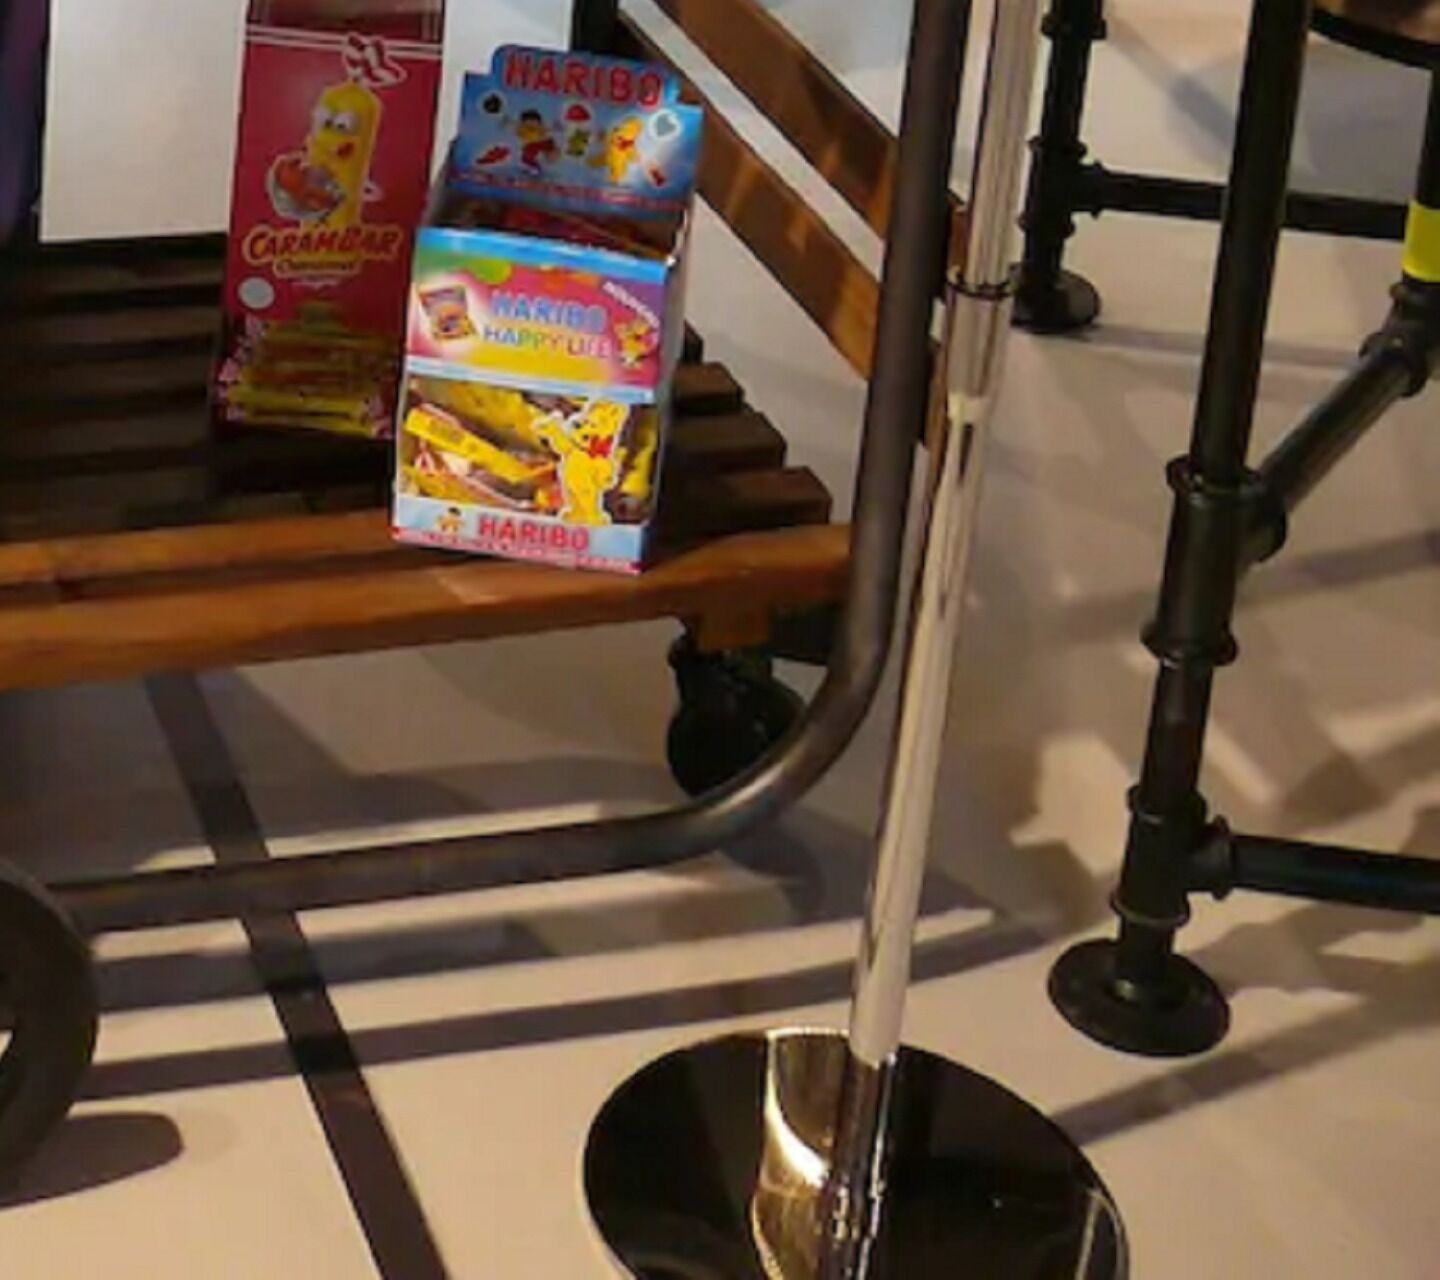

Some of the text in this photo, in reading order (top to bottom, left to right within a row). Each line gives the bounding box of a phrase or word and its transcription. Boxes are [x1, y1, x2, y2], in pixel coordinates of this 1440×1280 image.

[502, 51, 662, 110] HARIBO
[490, 288, 608, 335] HARIBO
[482, 324, 563, 350] HAPPY
[478, 514, 591, 552] HARIBO
